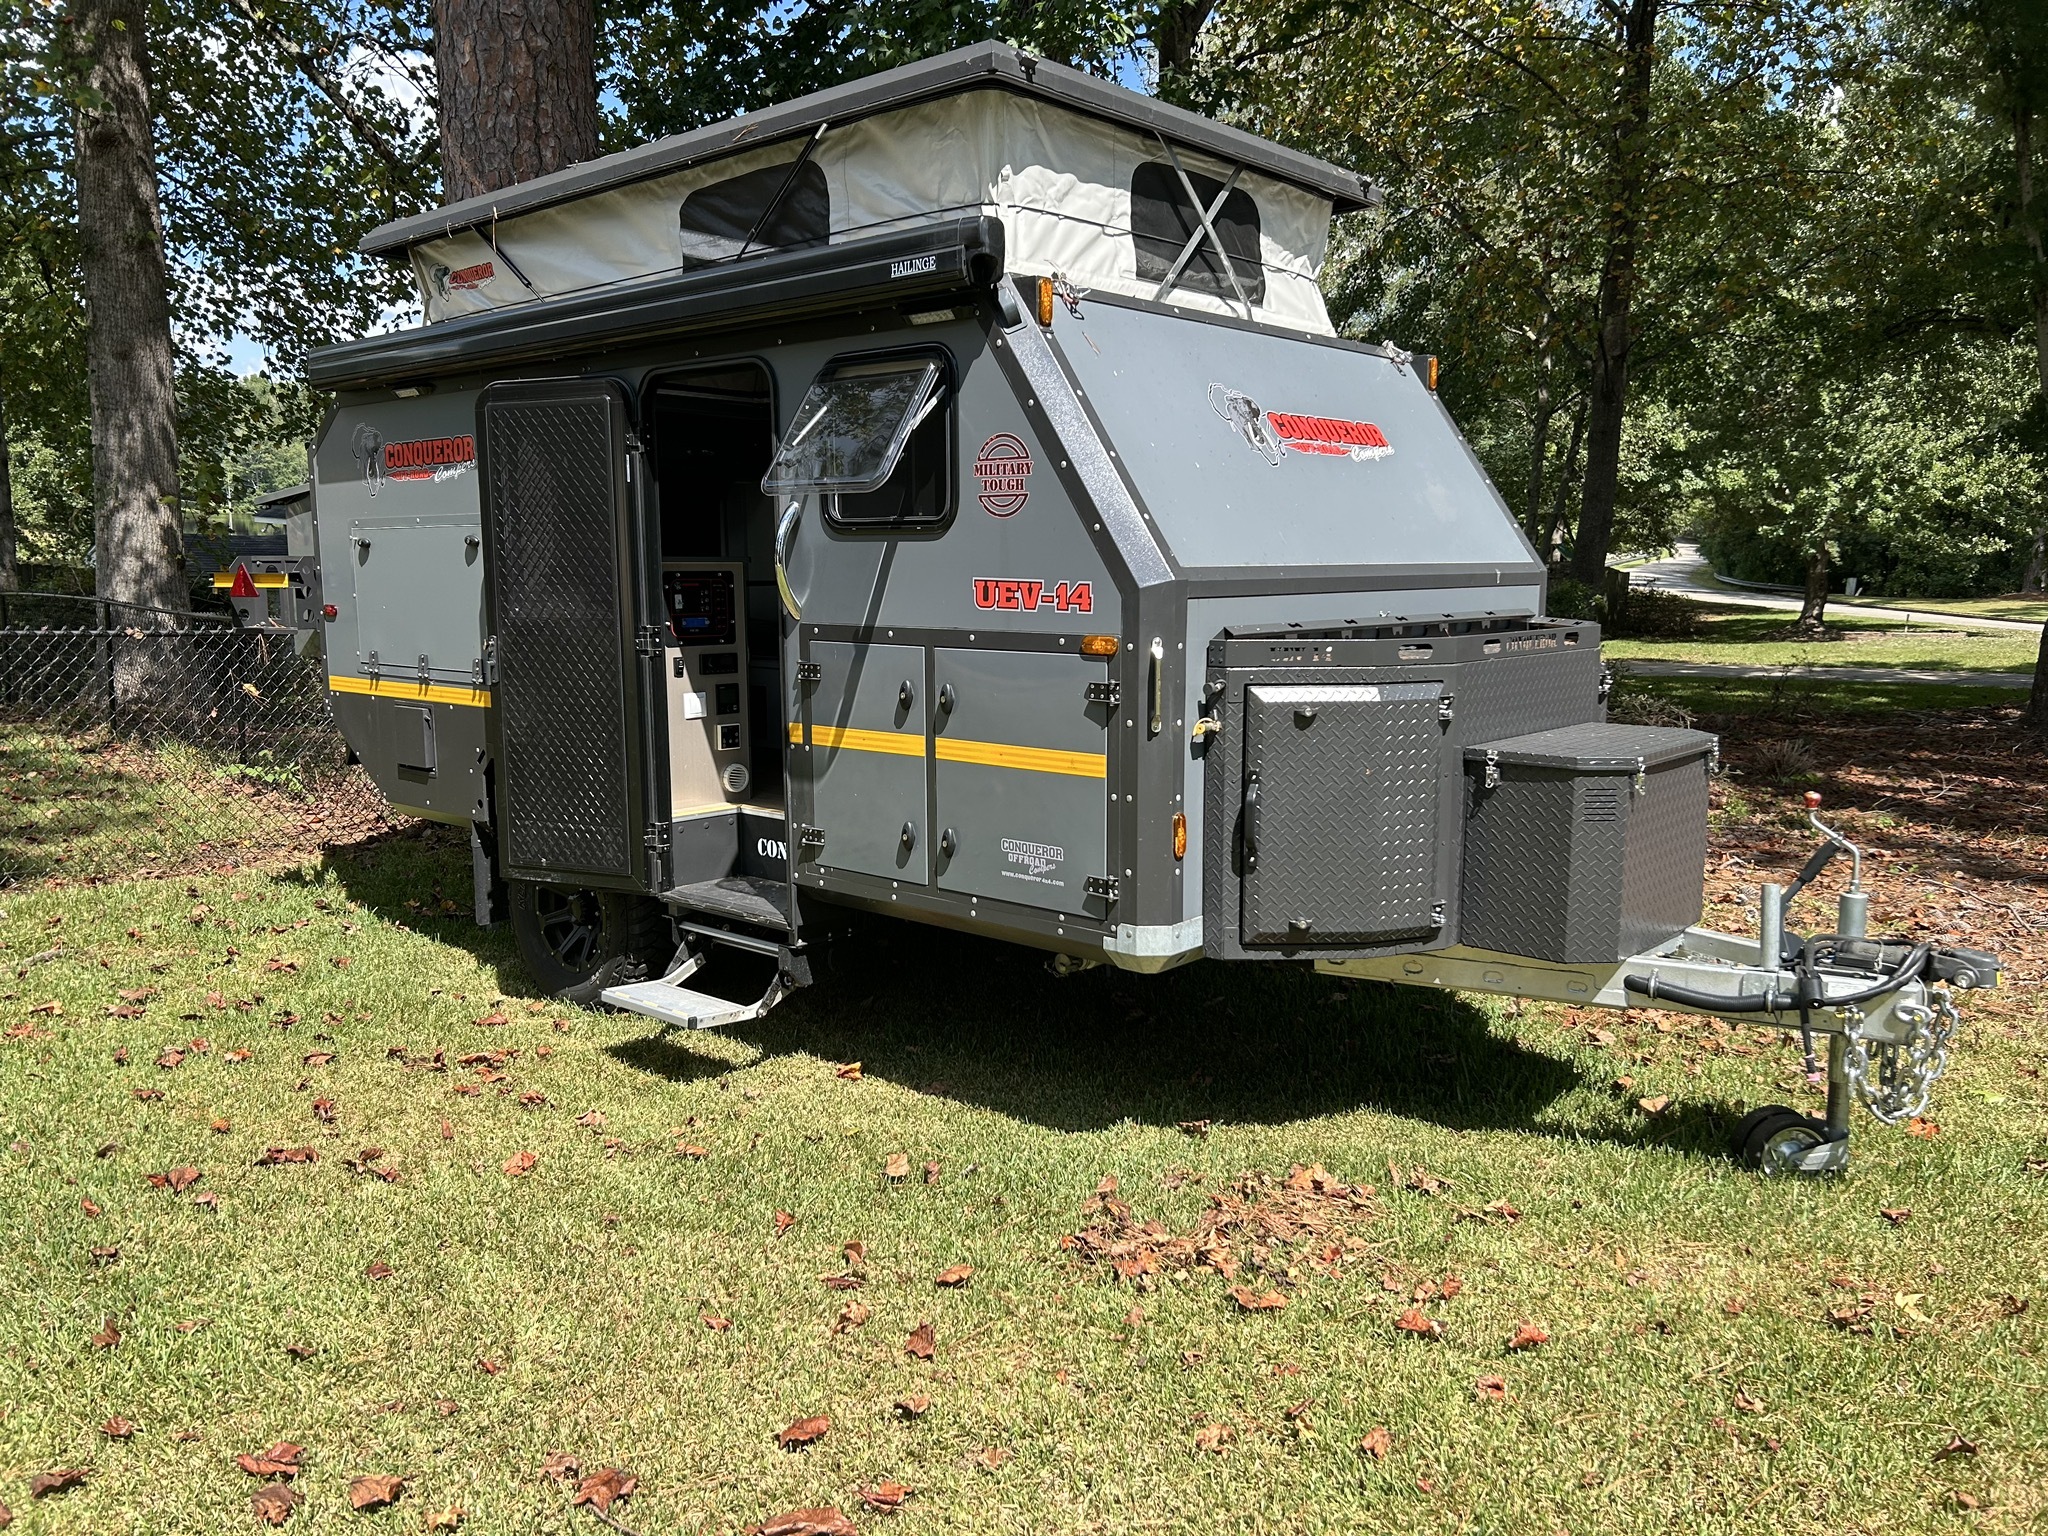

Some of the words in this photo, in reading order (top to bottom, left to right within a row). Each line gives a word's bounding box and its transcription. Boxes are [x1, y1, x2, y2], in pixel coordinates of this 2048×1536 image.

[449, 262, 494, 284] CONQUEROR
[891, 256, 936, 276] HAILINGE
[1266, 411, 1389, 448] CONQUEROR
[384, 434, 475, 469] CONQUEROR
[973, 461, 1034, 477] MILITARY
[981, 478, 1025, 492] TOUGH
[972, 577, 1093, 614] UEV-14
[1001, 838, 1064, 861] CONQUEROR
[1008, 853, 1046, 867] OFFROAD
